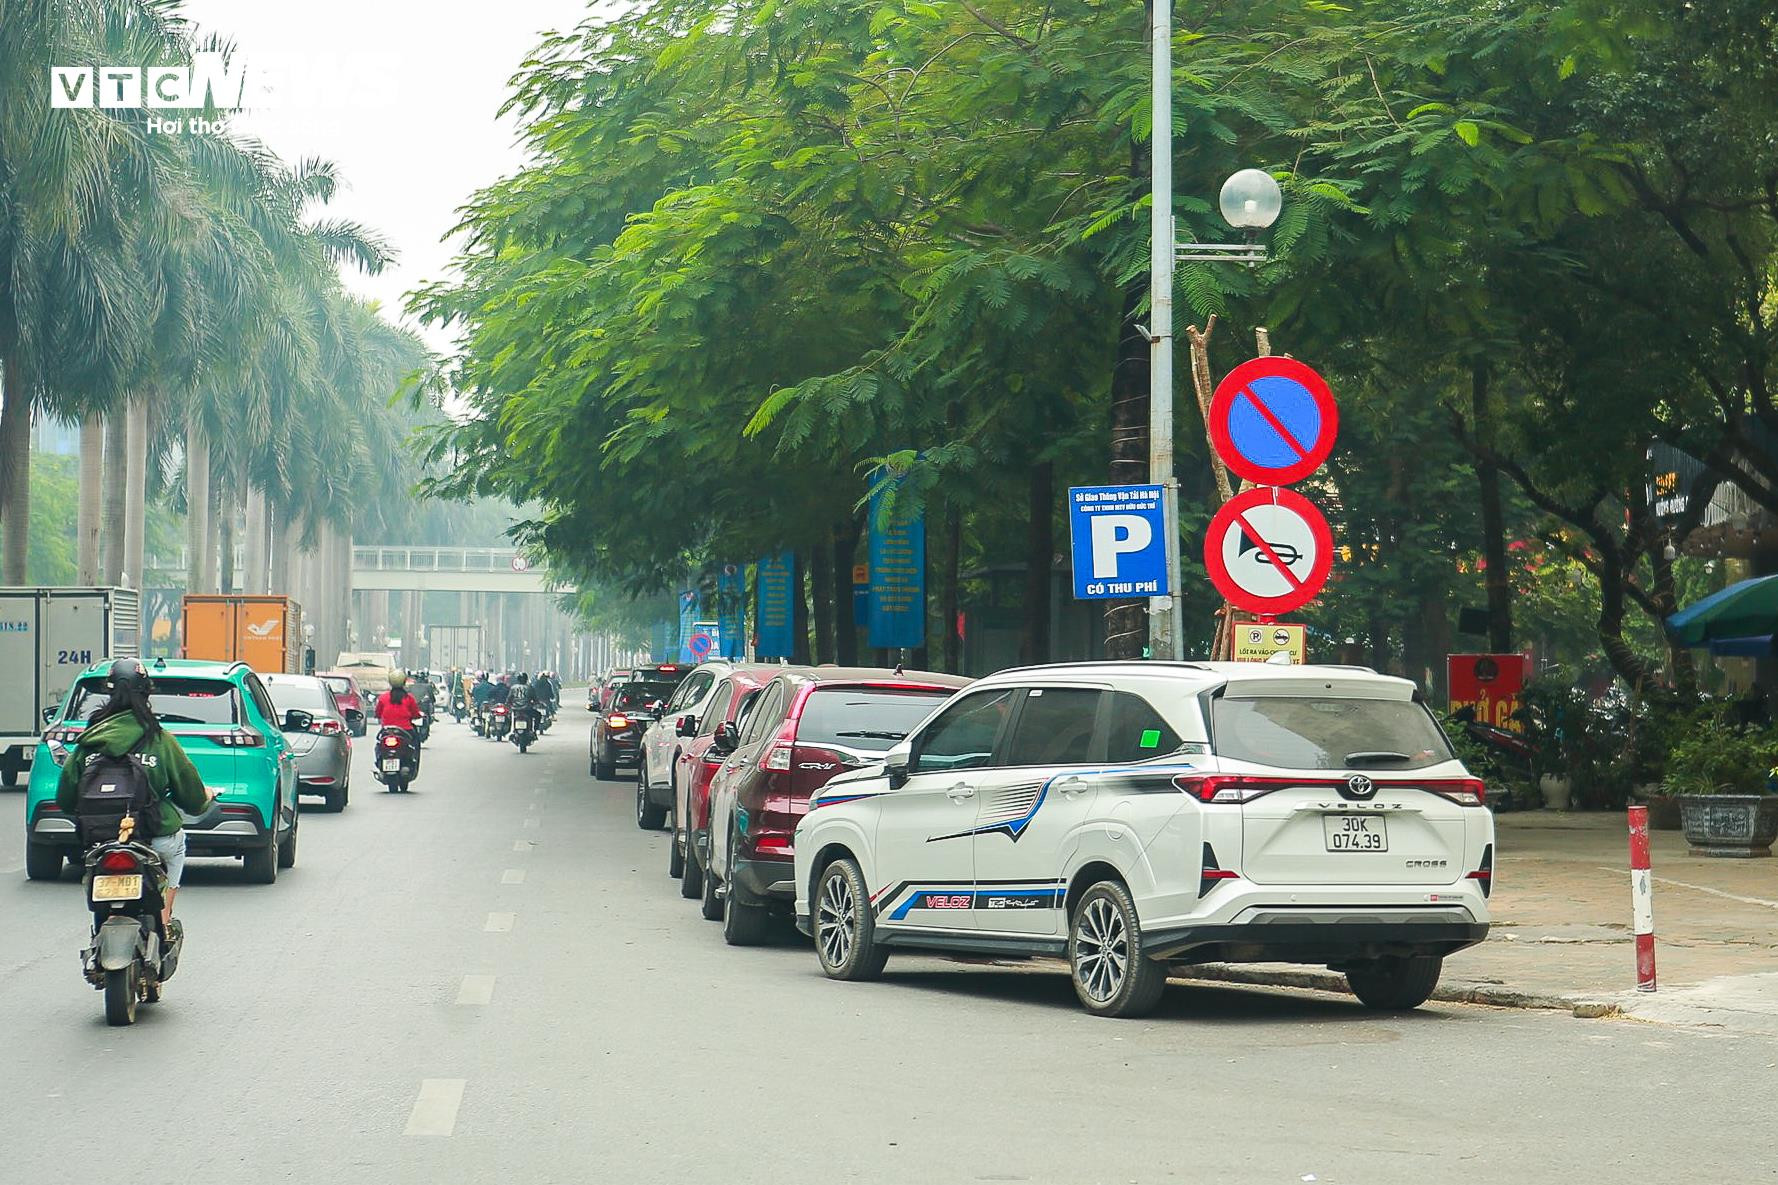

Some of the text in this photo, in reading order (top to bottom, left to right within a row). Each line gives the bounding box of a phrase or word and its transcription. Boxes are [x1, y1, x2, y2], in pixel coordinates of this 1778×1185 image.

[1090, 514, 1152, 579] P
[1086, 579, 1158, 595] CÓ THU PHÍ
[57, 650, 91, 664] 24H
[1342, 817, 1369, 831] 30K
[1333, 833, 1381, 849] 074.39
[1405, 860, 1448, 868] CROSS
[925, 895, 971, 908] VELOZ
